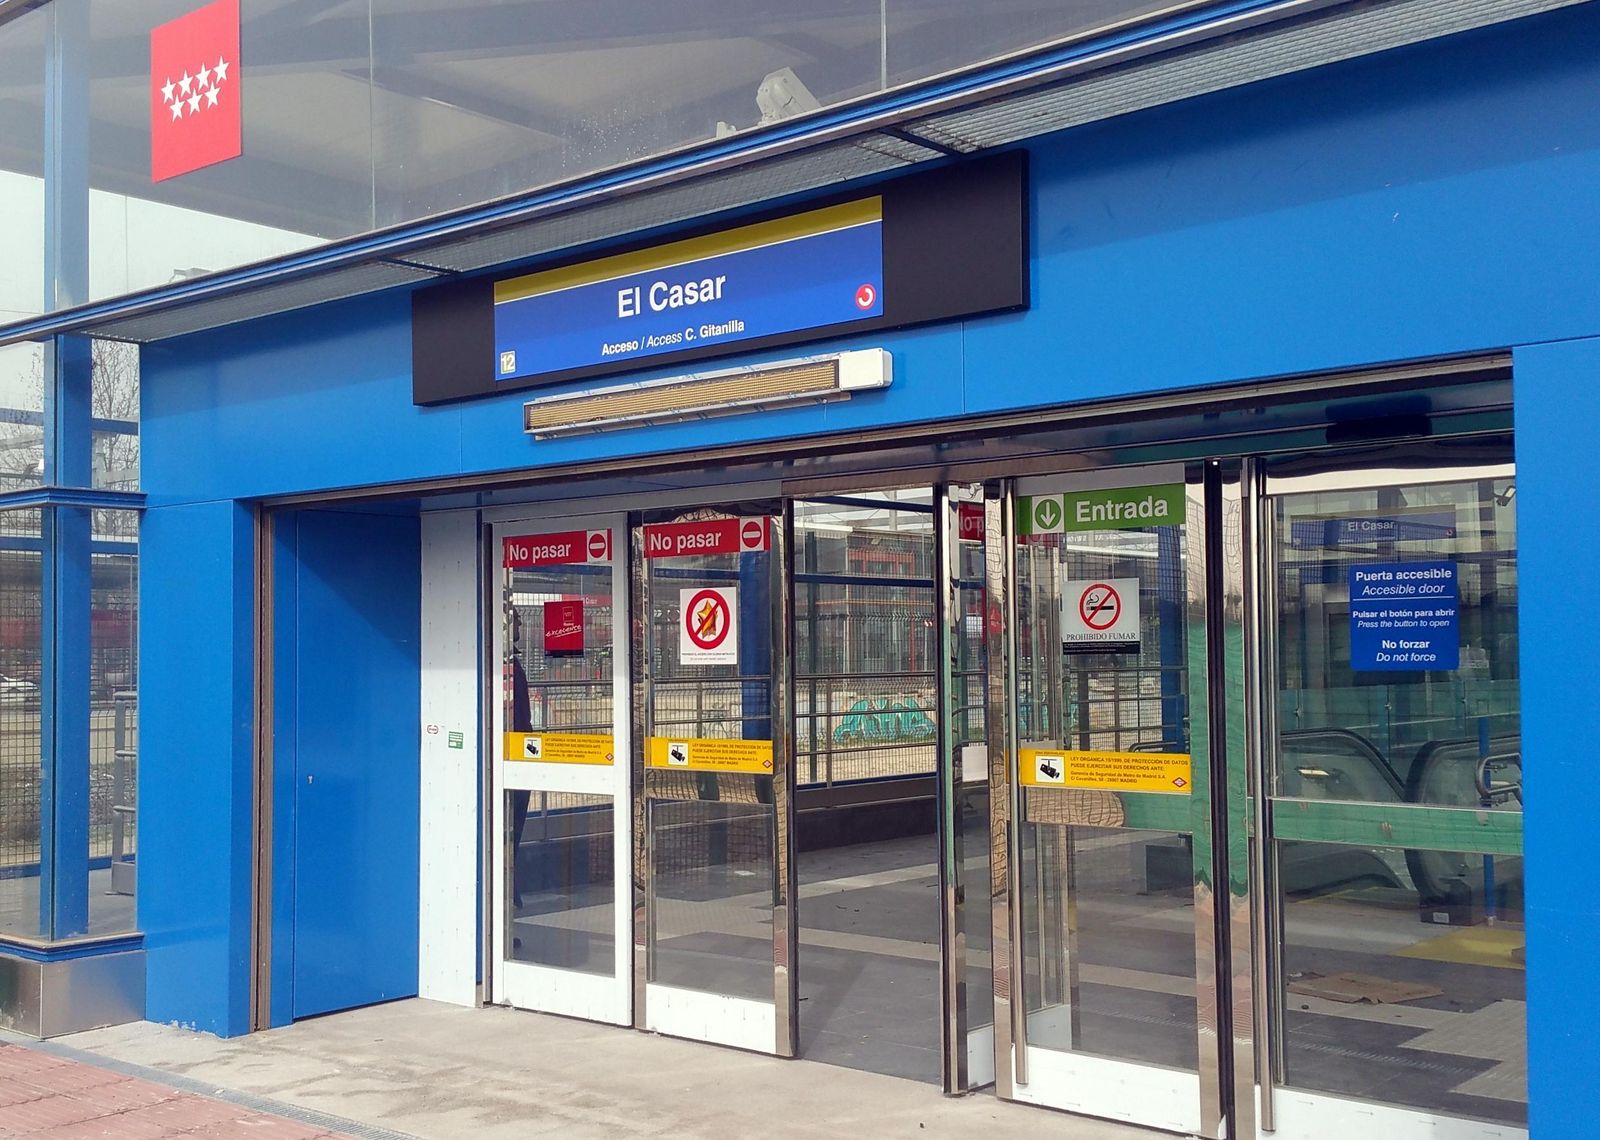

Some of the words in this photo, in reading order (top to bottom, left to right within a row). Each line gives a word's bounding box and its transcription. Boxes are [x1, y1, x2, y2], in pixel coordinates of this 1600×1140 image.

[618, 286, 640, 318] El
[650, 274, 726, 312] Casar
[602, 340, 639, 356] Acceso
[640, 336, 645, 350] /
[646, 332, 682, 348] Access
[684, 328, 697, 340] C.
[700, 320, 745, 338] Gitanilla
[502, 353, 514, 372] 12
[1076, 496, 1168, 522] Entrada
[1348, 521, 1358, 532] El
[1362, 520, 1394, 530] Casar
[650, 532, 672, 550] No
[677, 530, 722, 554] pasar
[509, 544, 528, 561] No
[532, 543, 572, 564] pasar
[1356, 571, 1393, 582] Puerta
[1396, 568, 1452, 580] accesible
[1362, 584, 1416, 596] Accesible
[1418, 584, 1446, 594] door
[1352, 610, 1378, 618] Pulsar
[1389, 608, 1412, 617] botón
[1414, 610, 1434, 618] para
[1435, 608, 1455, 616] abrir
[1066, 632, 1108, 640] PROHIBIDO
[1108, 632, 1136, 640] FUMAR
[1382, 640, 1397, 648] No
[1400, 639, 1430, 648] forzar
[1376, 652, 1390, 662] Do
[1392, 653, 1408, 662] not
[1410, 652, 1436, 662] force
